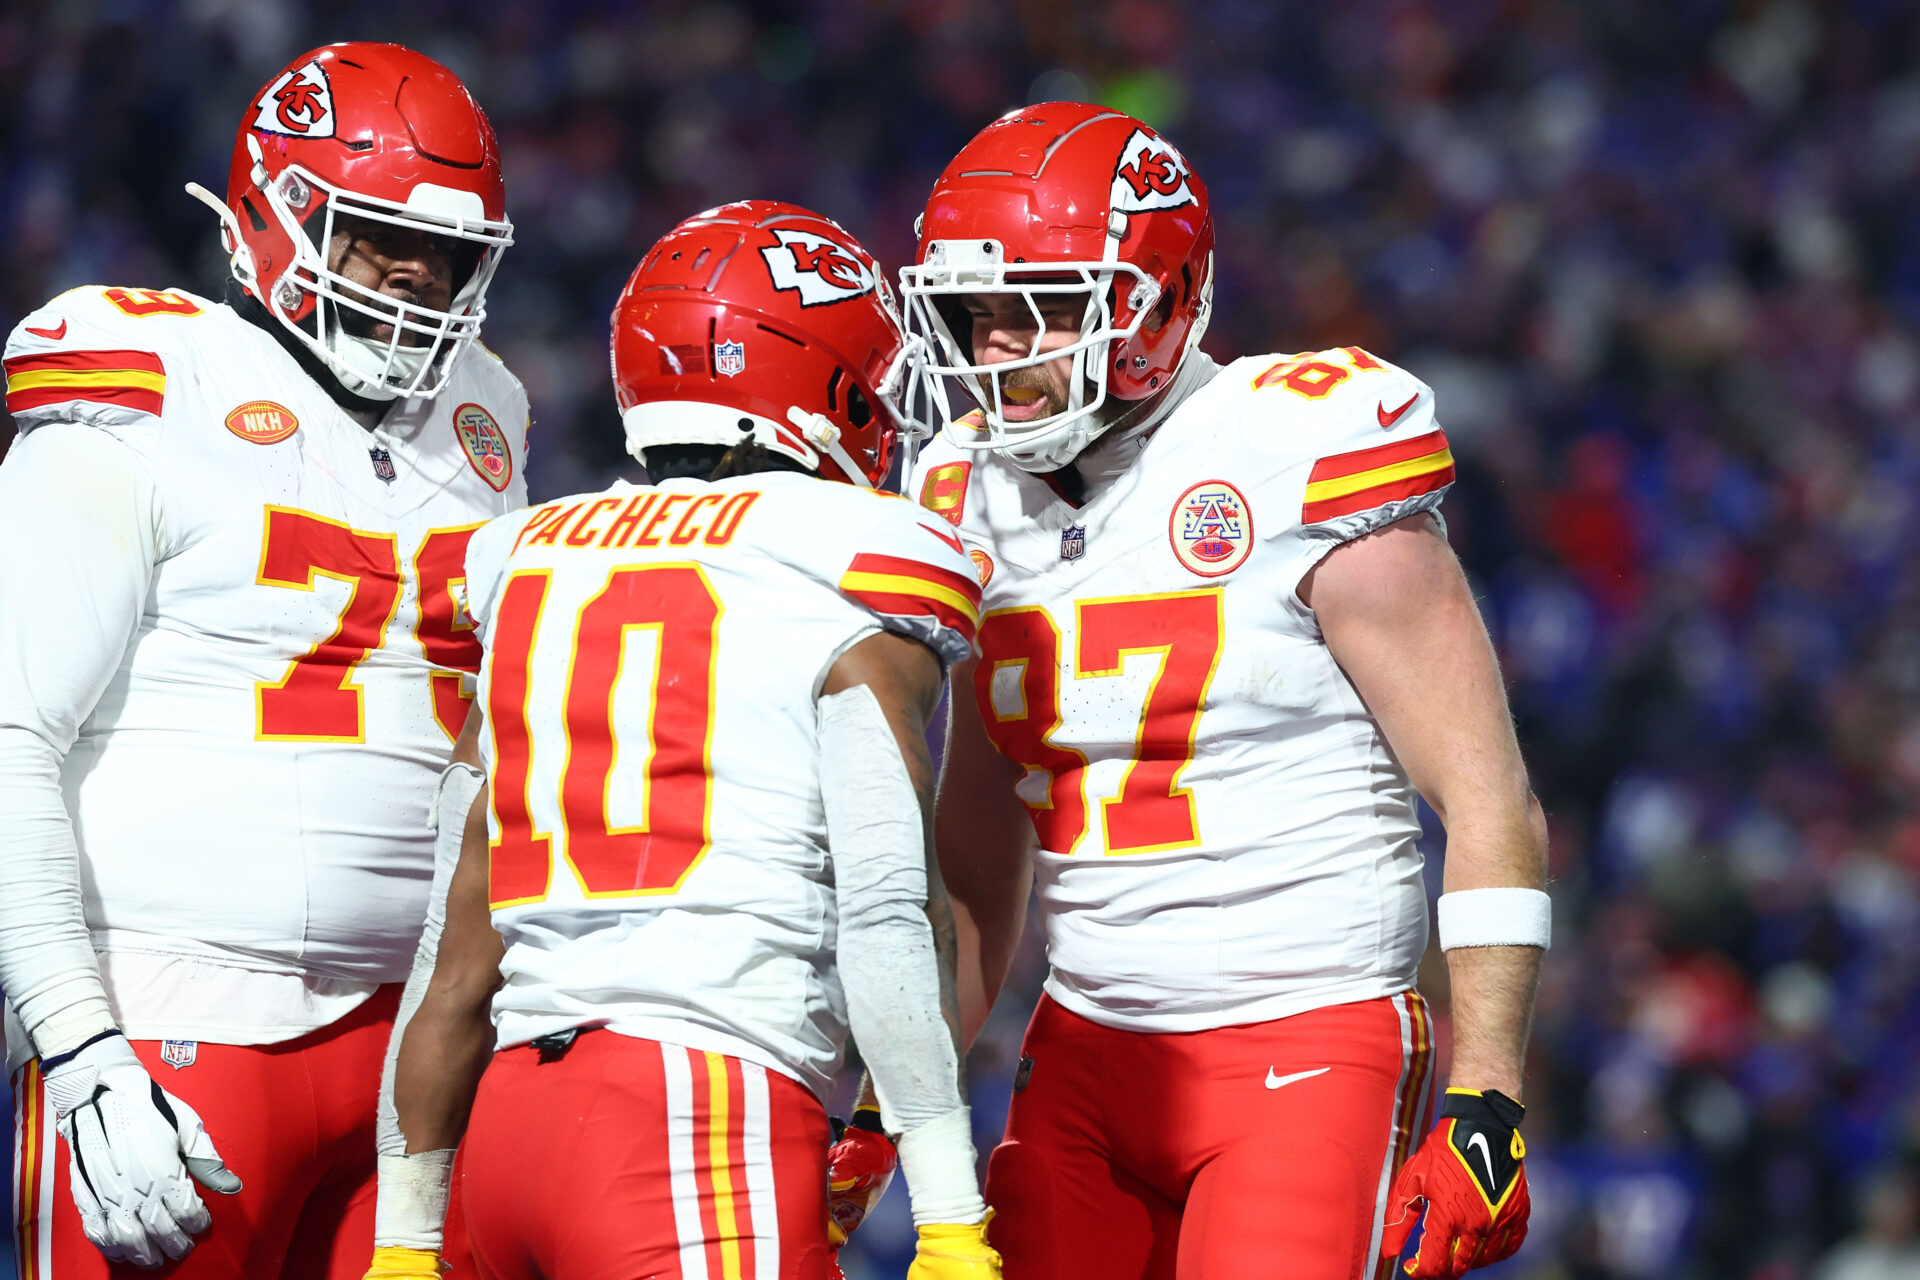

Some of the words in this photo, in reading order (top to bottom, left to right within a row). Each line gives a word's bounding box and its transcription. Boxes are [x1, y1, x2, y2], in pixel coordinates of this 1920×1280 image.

[720, 356, 741, 371] NFL
[243, 411, 284, 433] NKH
[923, 466, 965, 511] C
[507, 491, 762, 562] PACHECO
[1063, 540, 1083, 557] NFL
[488, 561, 725, 912] 10
[973, 587, 1224, 857] 87
[167, 1045, 191, 1062] NFL
